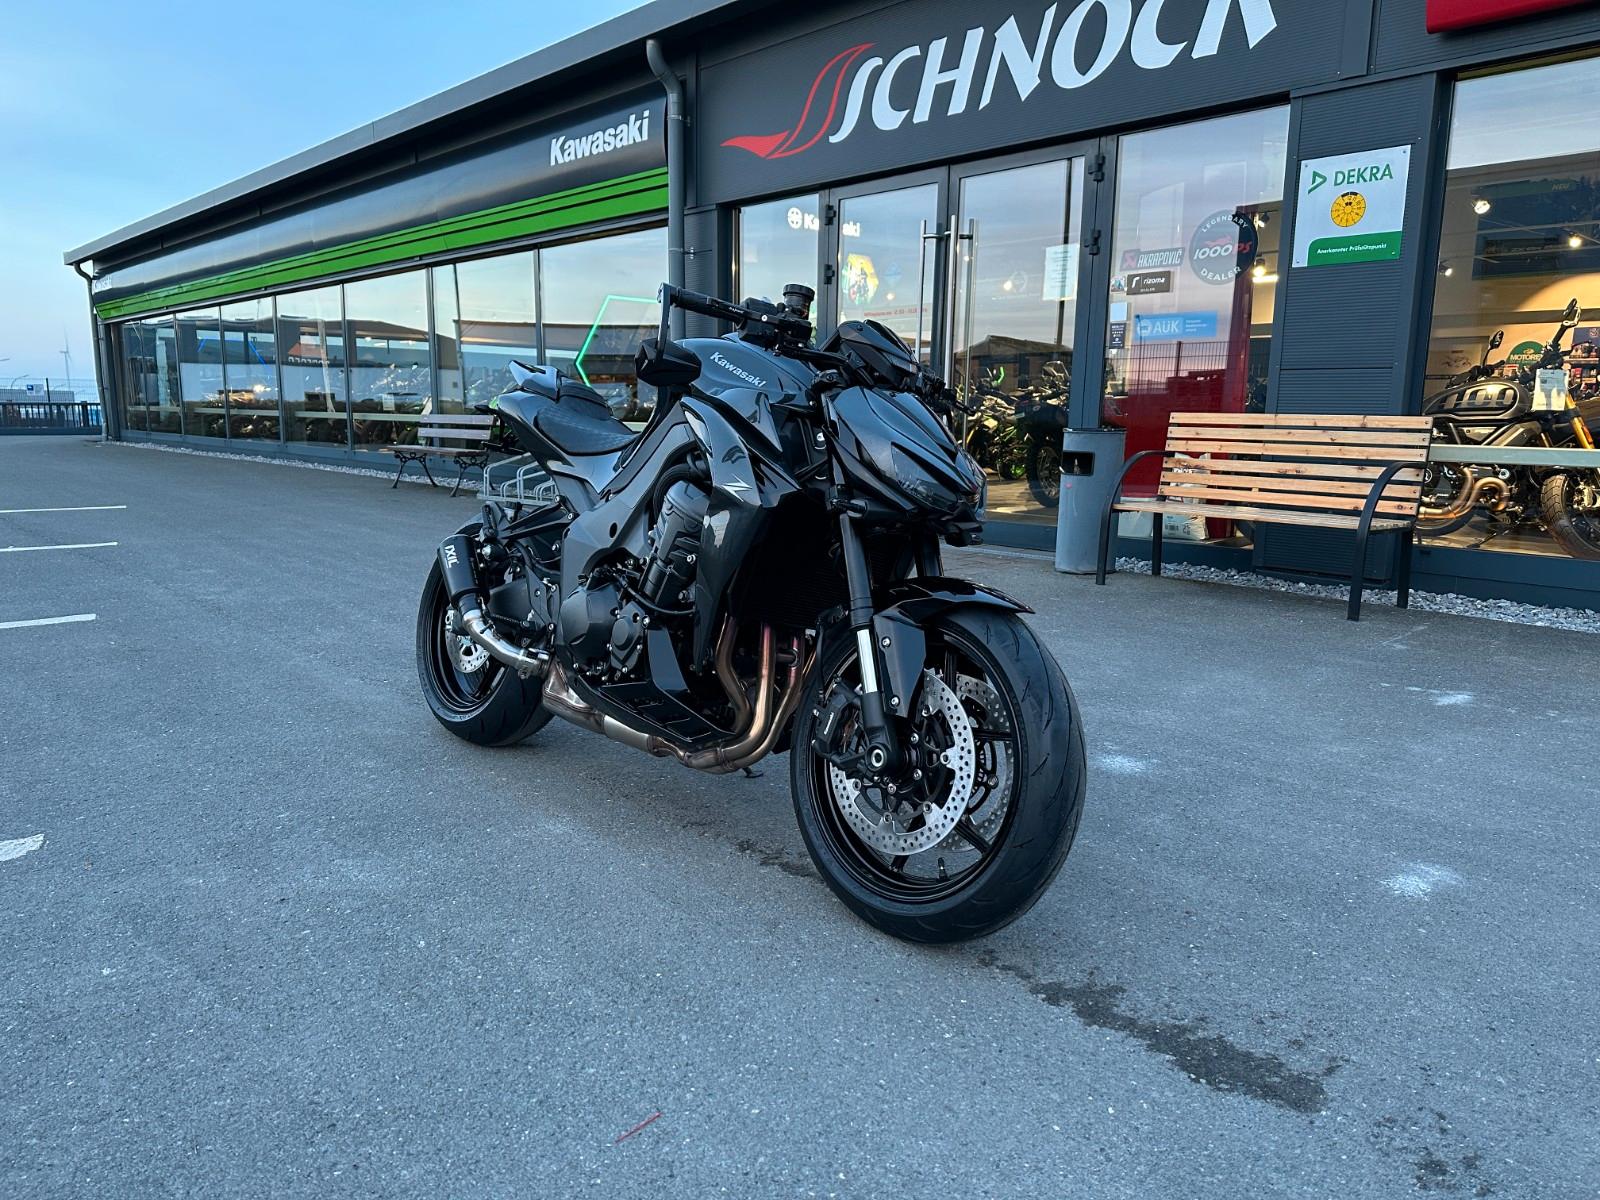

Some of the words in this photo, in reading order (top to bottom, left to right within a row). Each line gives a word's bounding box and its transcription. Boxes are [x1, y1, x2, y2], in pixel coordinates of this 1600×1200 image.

[550, 109, 650, 167] Kawasaki
[1333, 163, 1393, 187] DEKRA
[804, 213, 861, 237] Kaaki
[1201, 214, 1249, 233] LEGENDARY
[1143, 277, 1166, 285] rizoma
[1200, 265, 1242, 281] DEALER
[709, 351, 767, 387] Kawasaki
[444, 544, 459, 569] IXIL
